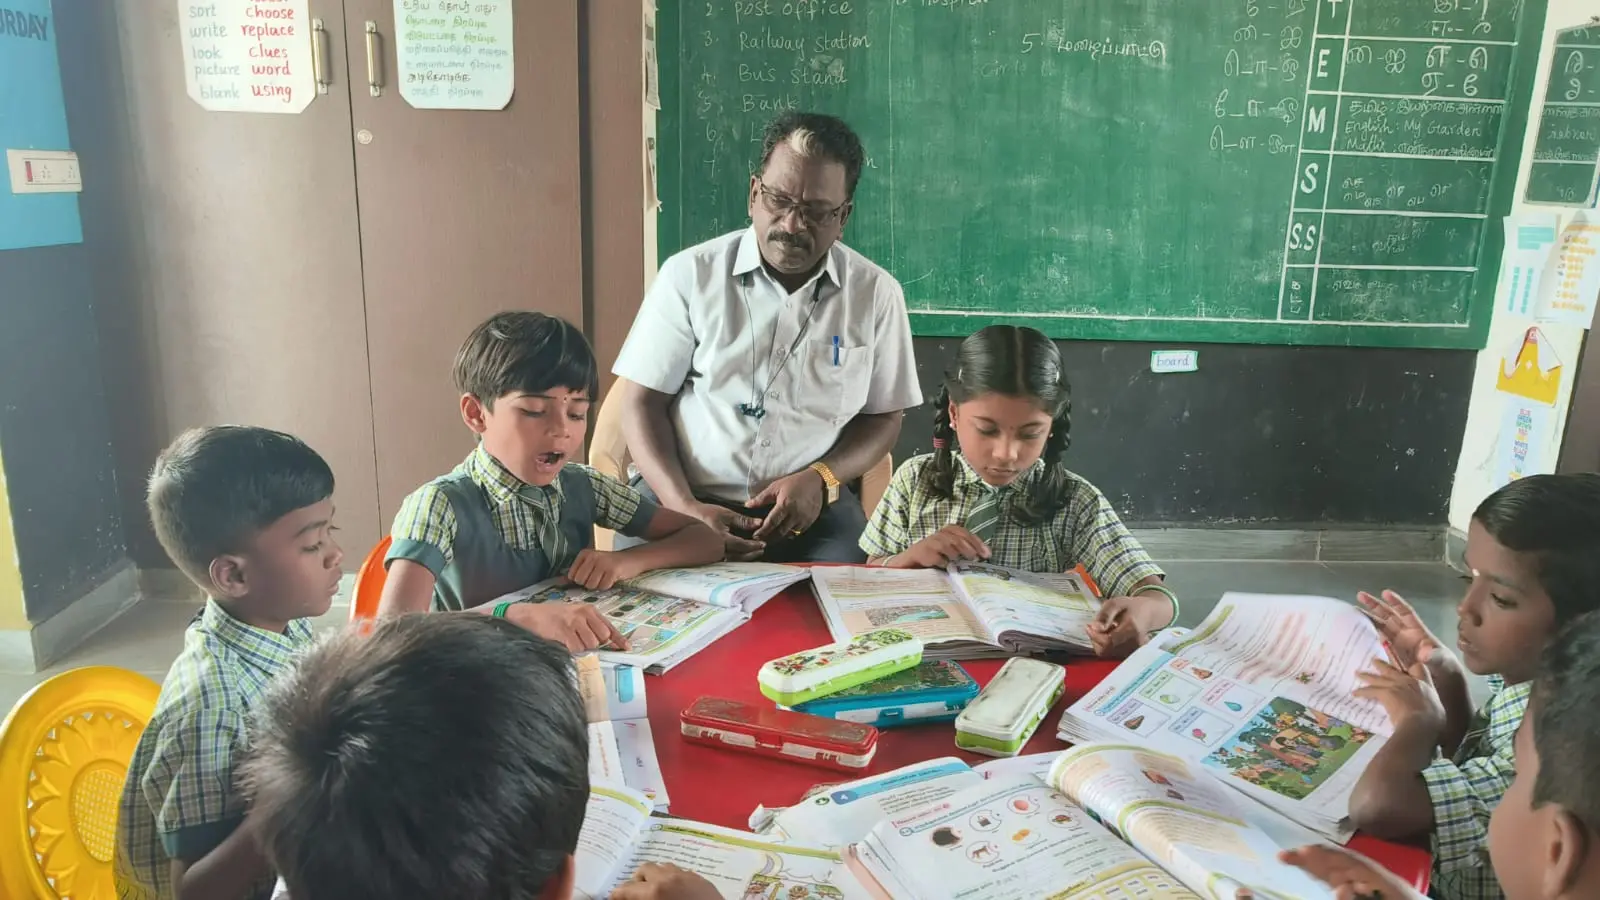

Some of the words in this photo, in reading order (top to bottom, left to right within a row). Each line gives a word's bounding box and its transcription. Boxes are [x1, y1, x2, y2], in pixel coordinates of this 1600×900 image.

[188, 5, 217, 18] sort
[245, 4, 294, 20] choose
[189, 22, 228, 38] write
[240, 23, 295, 41] replace
[191, 44, 223, 60] look
[248, 43, 288, 59] clues
[739, 26, 806, 60] Railway
[815, 31, 872, 53] station
[195, 64, 240, 80] picture
[251, 61, 292, 76] word
[1316, 50, 1331, 78] E
[200, 82, 240, 100] blank
[251, 83, 292, 103] using
[740, 94, 799, 113] Bank
[1307, 107, 1326, 135] M
[1403, 119, 1421, 138] My
[1301, 162, 1319, 194] S
[1156, 353, 1191, 367] board
